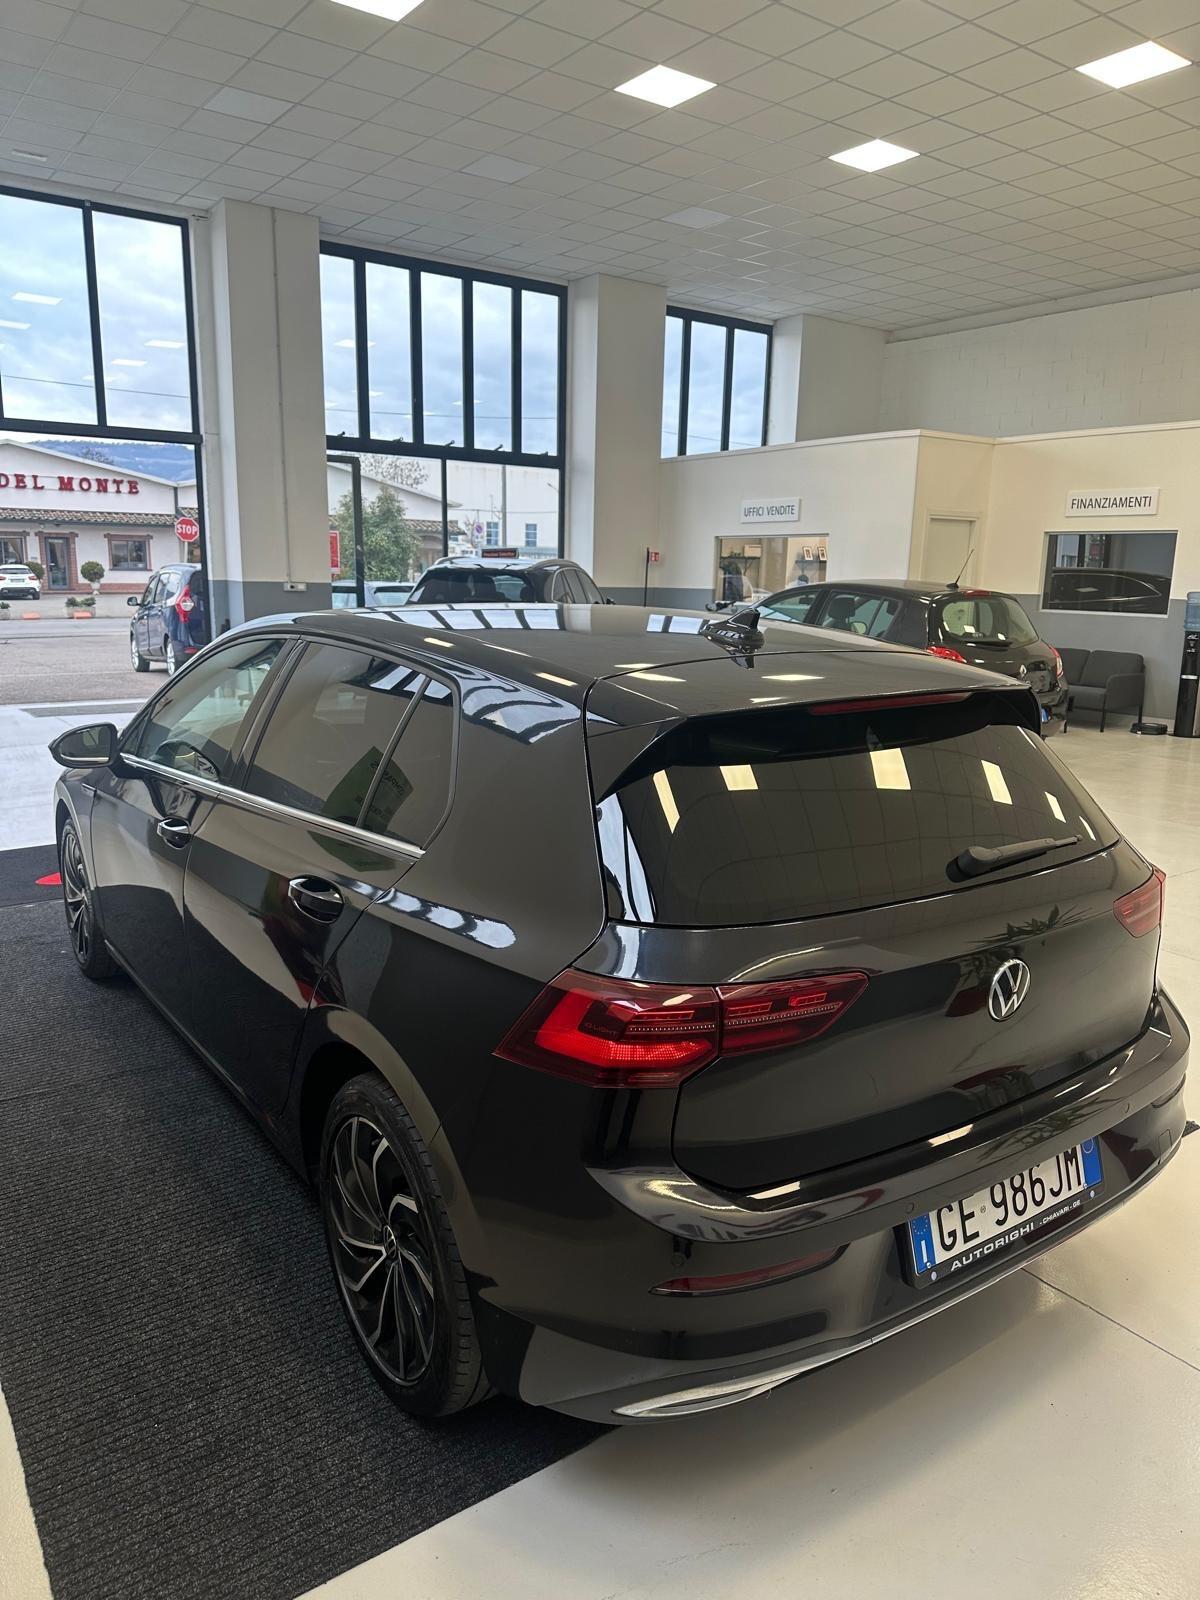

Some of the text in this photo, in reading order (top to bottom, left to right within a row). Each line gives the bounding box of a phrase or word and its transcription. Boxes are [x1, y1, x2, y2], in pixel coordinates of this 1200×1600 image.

[58, 476, 140, 494] MONTE
[1071, 496, 1152, 509] FINANZIAMENTI
[744, 504, 795, 517] UFFICI VENDITE
[177, 524, 197, 534] STOP
[936, 1199, 980, 1252] GE
[951, 1222, 1034, 1271] AUTORIGHI
